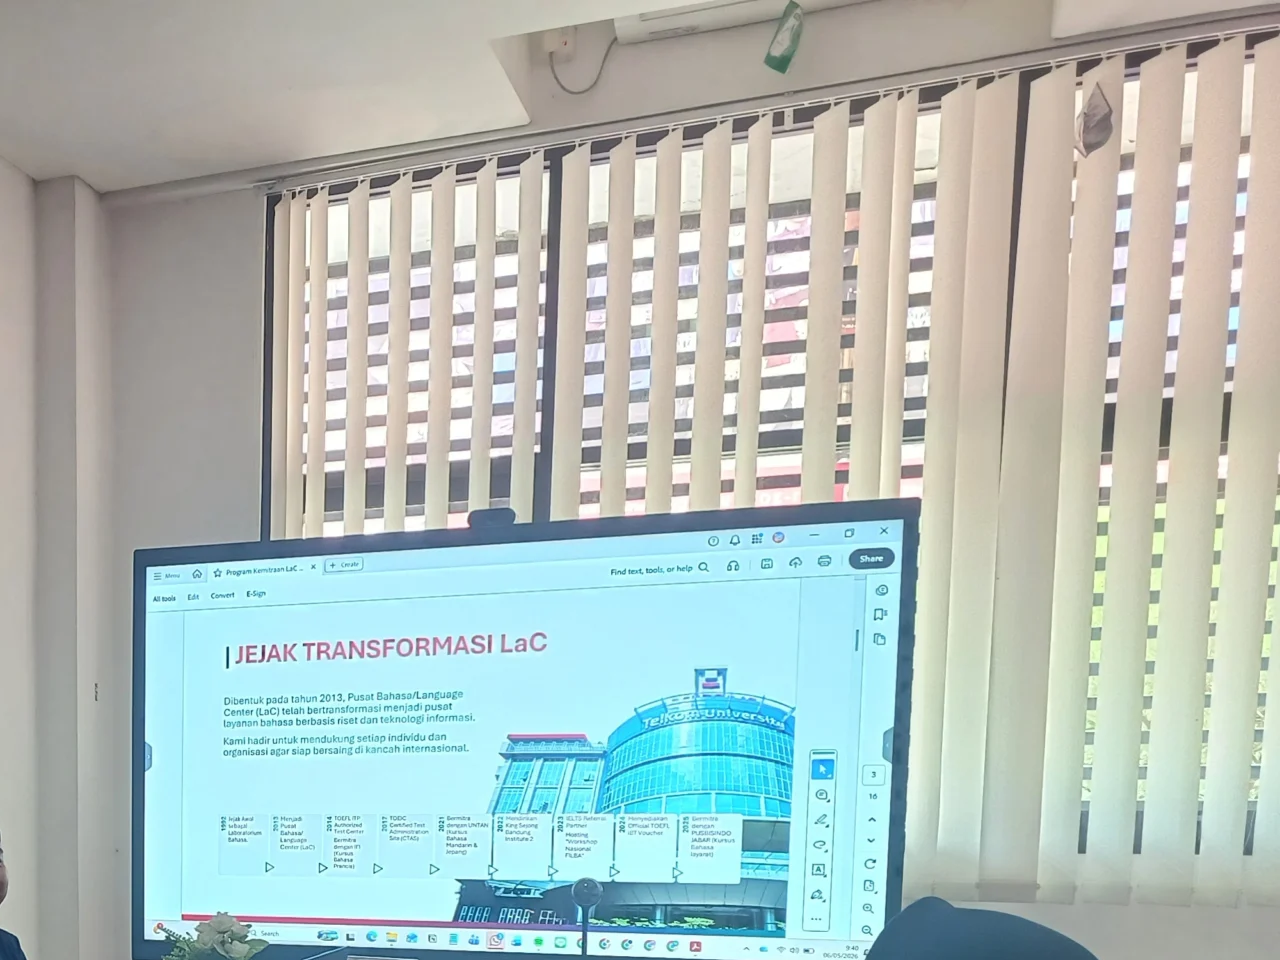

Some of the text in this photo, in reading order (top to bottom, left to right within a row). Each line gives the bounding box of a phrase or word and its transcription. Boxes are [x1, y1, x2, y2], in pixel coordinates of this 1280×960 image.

[860, 554, 884, 564] Share
[226, 567, 251, 577] Program
[646, 566, 665, 574] tools,
[677, 565, 693, 573] help
[162, 594, 176, 602] tools
[246, 590, 266, 598] E-Sign
[235, 631, 547, 664] JEJAK TRANSFORMASI LaC
[223, 689, 463, 706] Dibentuk pada tahun 2013, Pusat Bahasa/Language
[223, 702, 452, 717] Center (LaC) telah bertransformasi menjadi pusat
[223, 712, 476, 729] layanan bahasa berbasis riset dan teknologi informasi.
[642, 708, 785, 730] Telkom University
[223, 732, 446, 746] Kami hadir untuk mendukung setiap individu dan
[223, 743, 469, 758] organisasi agar siap bersaing di kancah internasional.
